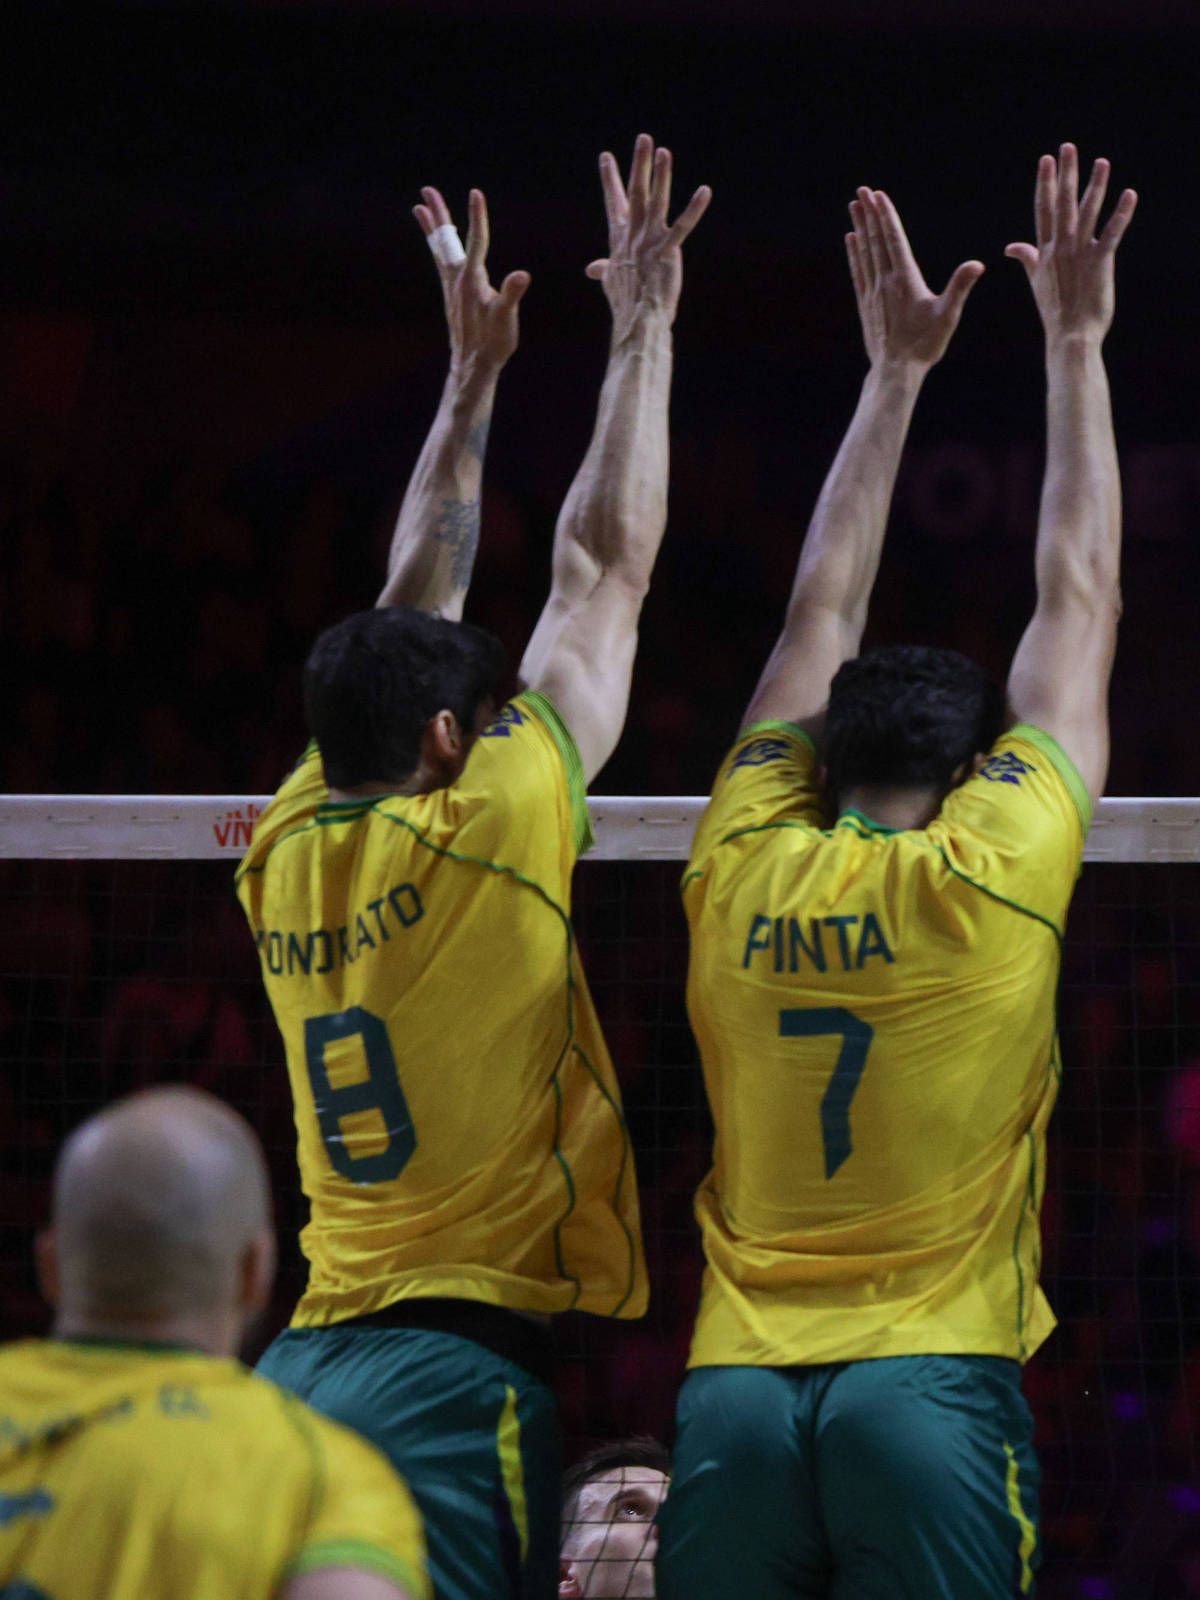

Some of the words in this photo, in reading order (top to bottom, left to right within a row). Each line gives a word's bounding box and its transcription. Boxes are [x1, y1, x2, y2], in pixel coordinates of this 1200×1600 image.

[742, 912, 895, 973] PINTA
[303, 1006, 417, 1185] 8
[778, 1006, 874, 1181] 7
